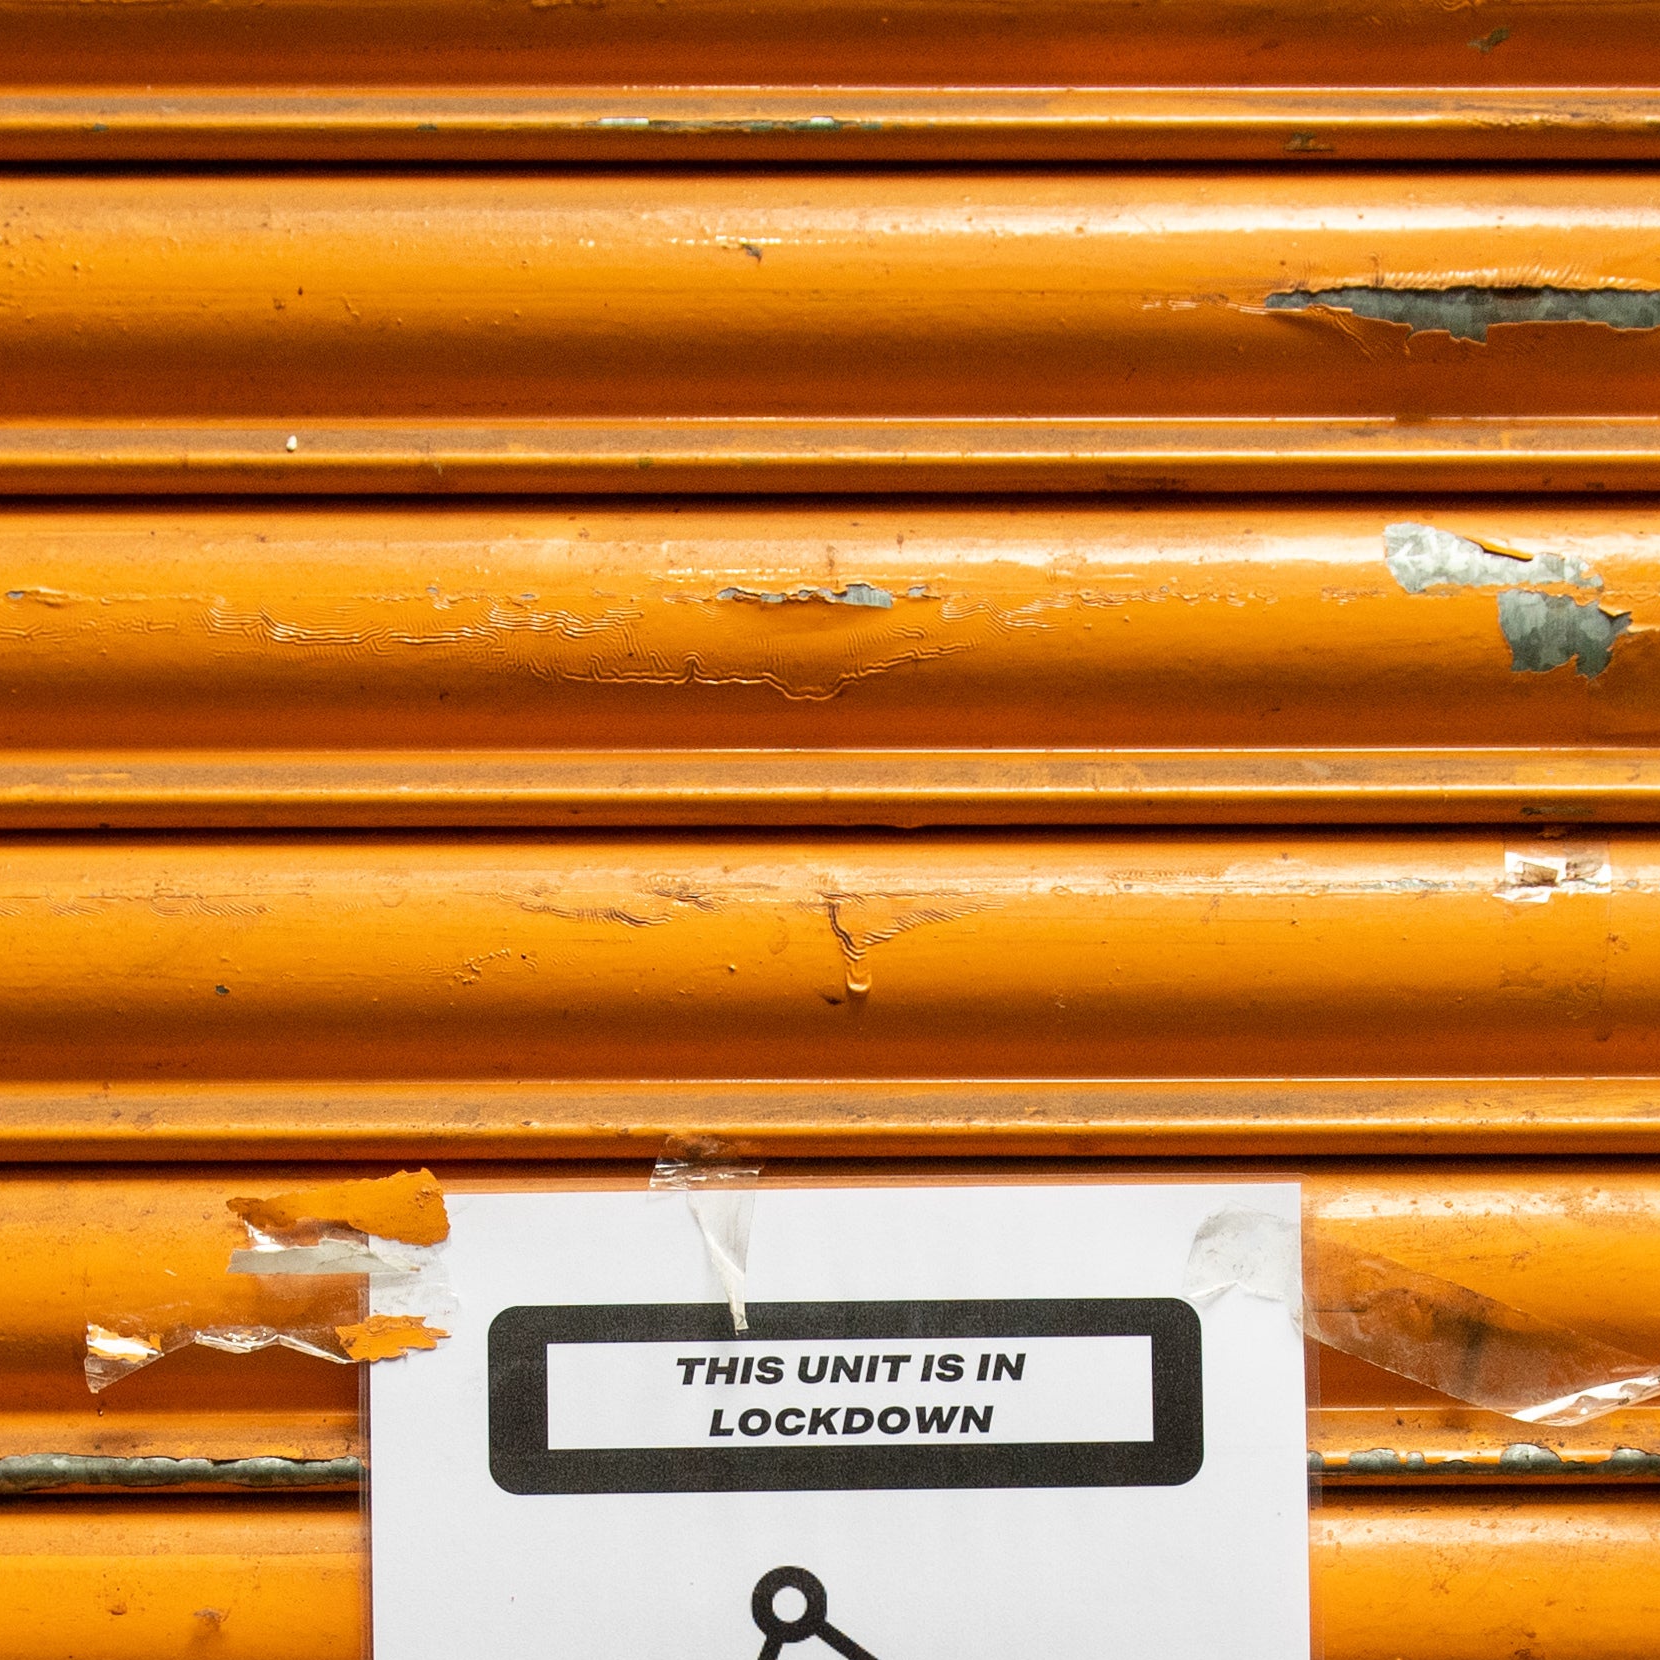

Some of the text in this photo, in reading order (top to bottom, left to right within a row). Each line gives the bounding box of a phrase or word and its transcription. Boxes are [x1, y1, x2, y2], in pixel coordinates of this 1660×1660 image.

[676, 1353, 1026, 1385] THIS UNIT IS IN
[709, 1405, 994, 1437] LOCKDOWN
